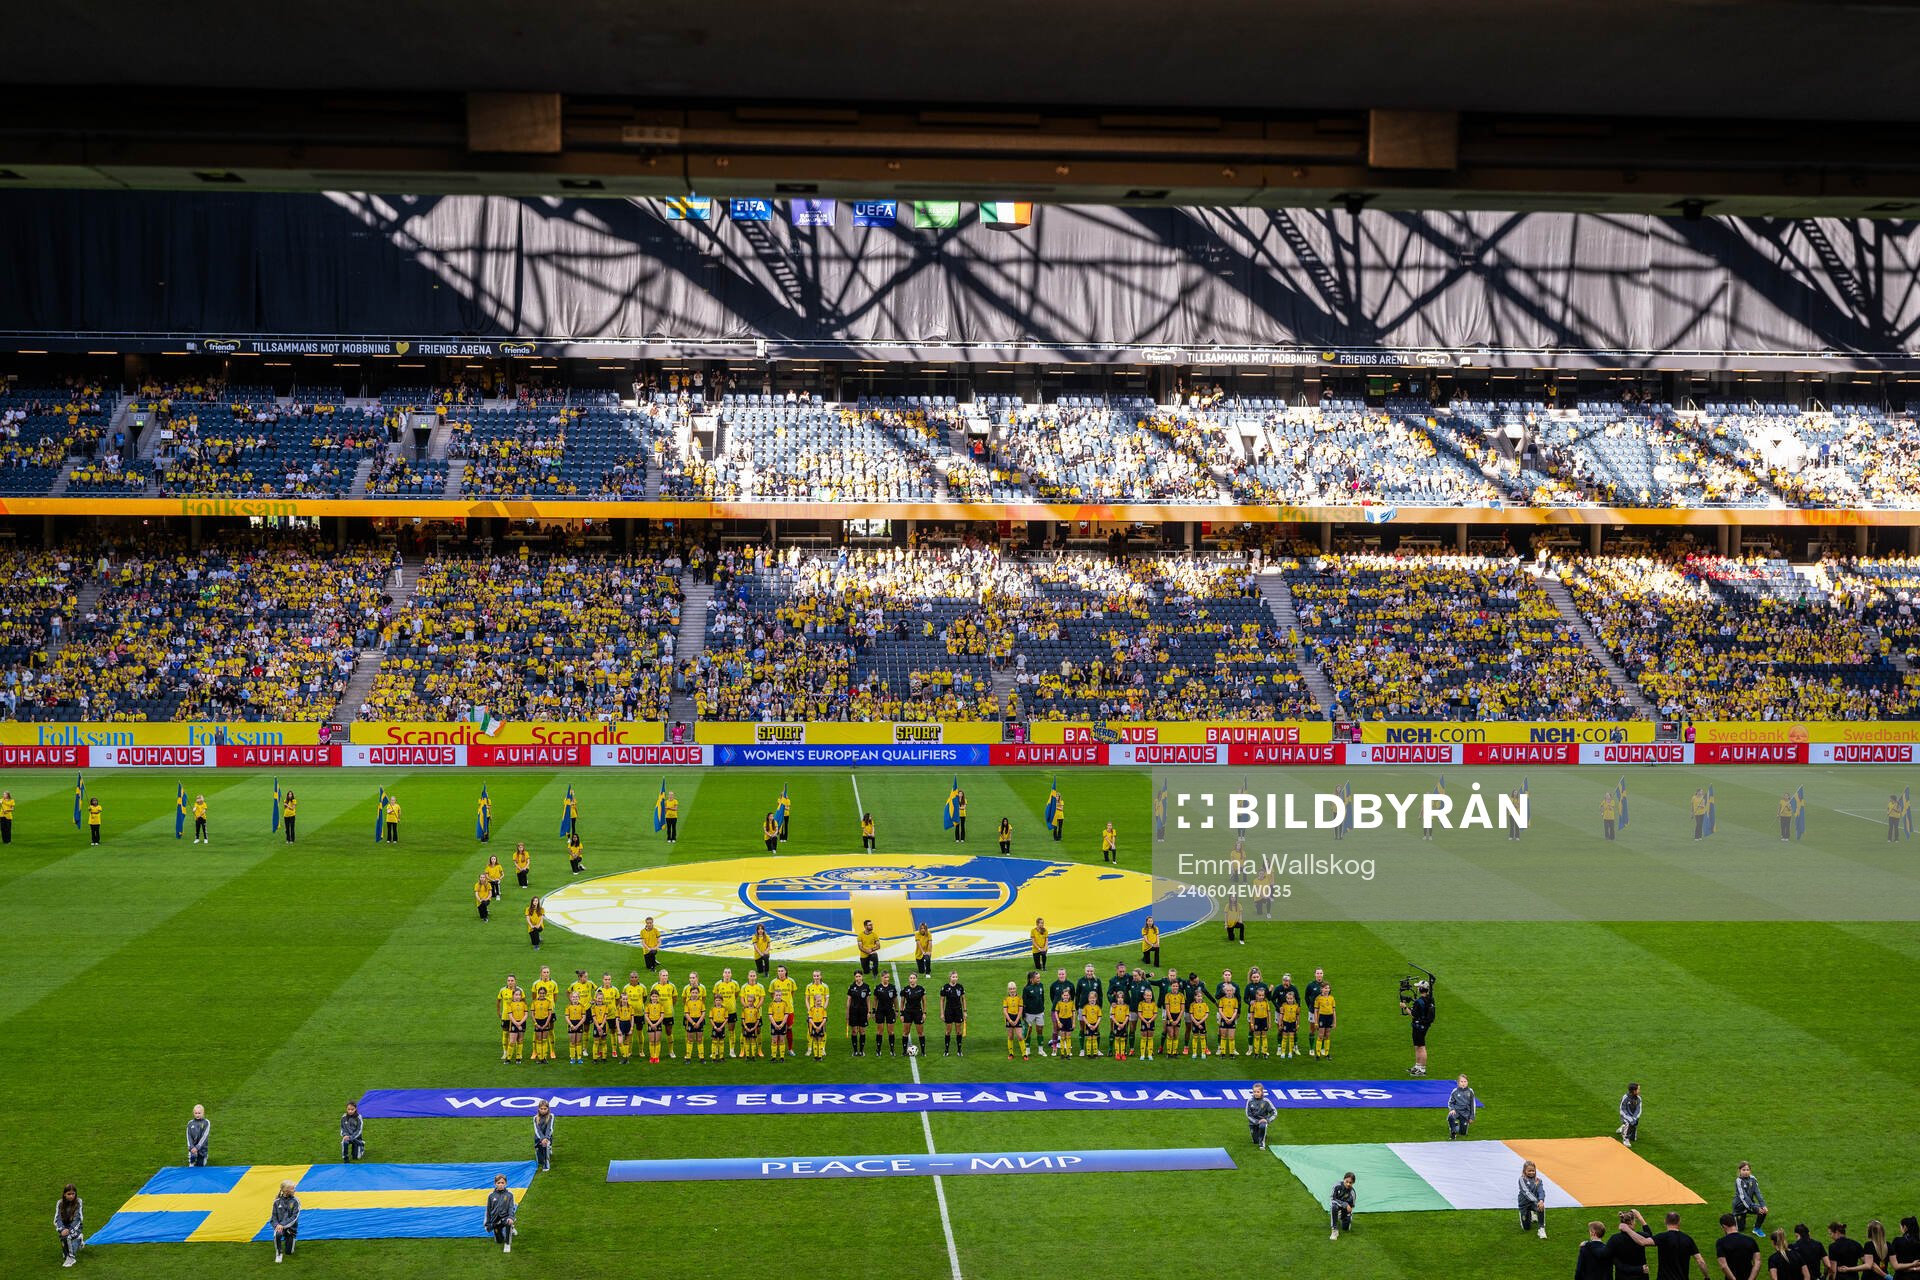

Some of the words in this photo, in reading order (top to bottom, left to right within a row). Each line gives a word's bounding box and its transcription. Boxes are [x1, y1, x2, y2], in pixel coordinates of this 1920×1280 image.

[736, 200, 766, 212] FIFA
[855, 205, 894, 217] UEFA
[252, 342, 318, 353] TILLSAMMANS
[320, 343, 340, 353] MOT
[342, 343, 391, 354] MOBBNING
[418, 344, 458, 354] FRIENDS
[460, 345, 492, 355] ARENA
[1186, 352, 1250, 363] TILLSAMMANS
[1251, 353, 1270, 364] MOT
[1271, 353, 1318, 364] MOBBNING
[1340, 354, 1377, 364] FRIENDS
[1379, 355, 1409, 365] ARENA
[181, 500, 298, 516] Folksam
[37, 726, 135, 746] Folksam
[531, 725, 629, 746] Scandic
[757, 725, 803, 741] SPORT
[895, 725, 941, 741] SPORT
[1206, 728, 1299, 742] BAUHAUS
[1708, 728, 1784, 742] Swedbank
[1844, 728, 1919, 742] Swedbank
[743, 749, 804, 761] WOMEN'S
[807, 749, 879, 761] EUROPEAN
[881, 749, 957, 762] QUALIFIERS
[784, 883, 970, 891] SVERIGE
[444, 1094, 718, 1109] WOMEN'S
[735, 1090, 1048, 1106] EUROPEAN
[1063, 1087, 1394, 1103] QUALIFIERS
[760, 1159, 916, 1175] PEACE
